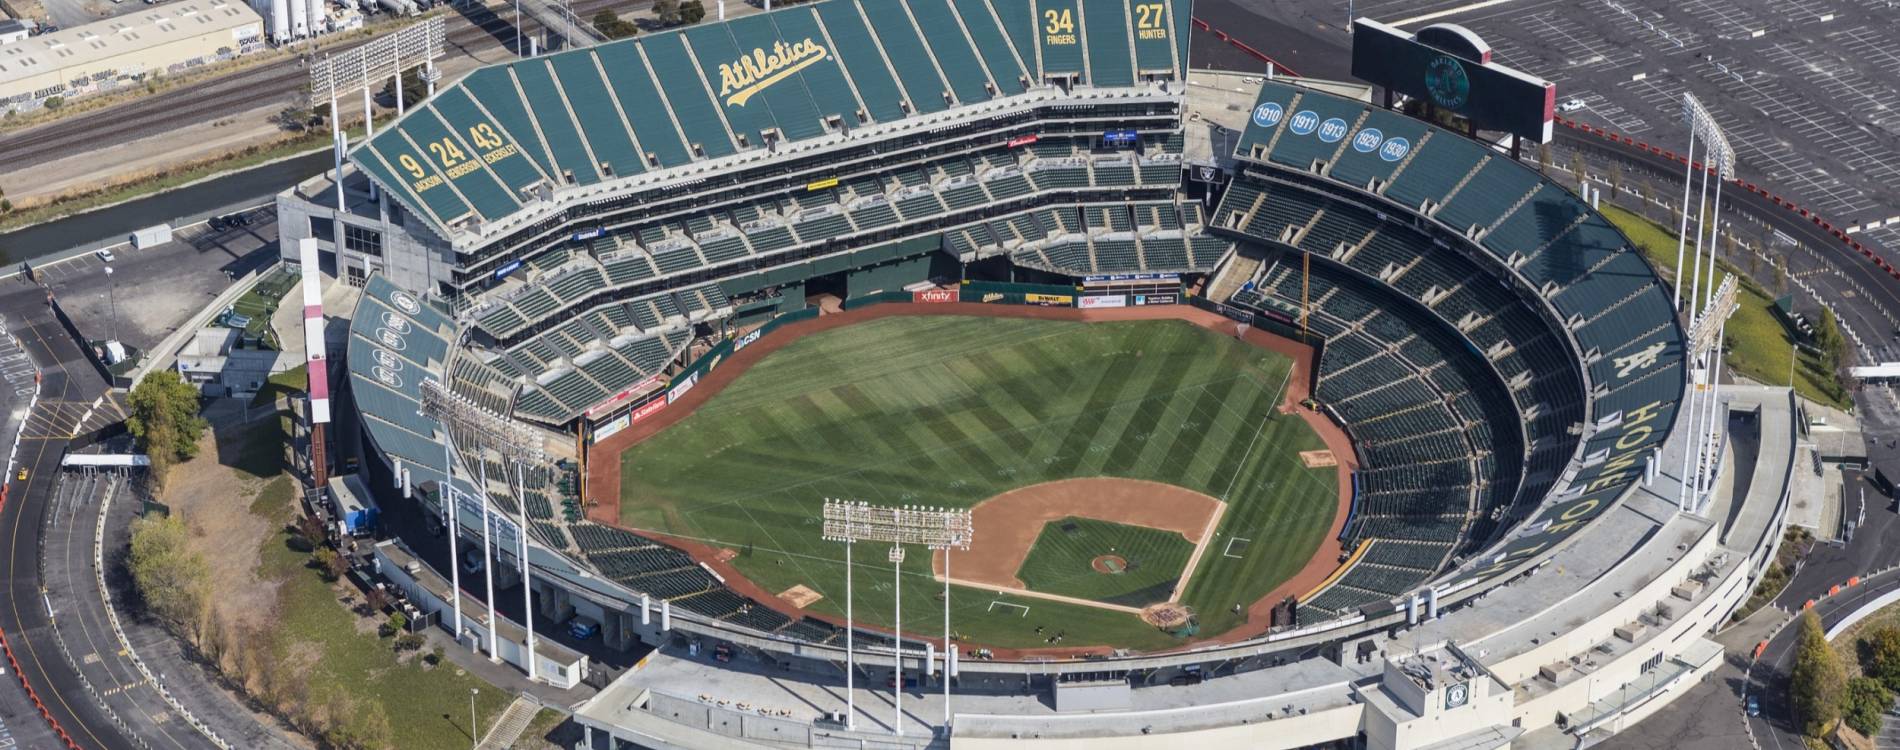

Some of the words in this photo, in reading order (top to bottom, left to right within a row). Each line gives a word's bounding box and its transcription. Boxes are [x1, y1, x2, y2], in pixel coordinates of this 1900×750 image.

[1045, 9, 1073, 34] 34
[1136, 4, 1163, 28] 27
[1046, 34, 1075, 45] FINGERS
[1139, 29, 1166, 39] HUNTER
[719, 38, 827, 106] Athletics
[1257, 107, 1280, 119] 1910
[1294, 115, 1315, 130] 1911
[469, 123, 502, 150] 43
[1321, 123, 1345, 137] 1913
[1356, 131, 1379, 148] 1929
[429, 137, 466, 167] 24
[483, 143, 517, 164] ECKERSLEY
[1383, 141, 1406, 157] 1930
[400, 154, 424, 178] 9
[445, 159, 481, 179] HENDERSON
[413, 174, 443, 193] JACKSON
[921, 290, 951, 302] xfinity
[744, 329, 760, 345] CSN
[1587, 400, 1661, 492] HOME
[1548, 499, 1599, 533] OF
